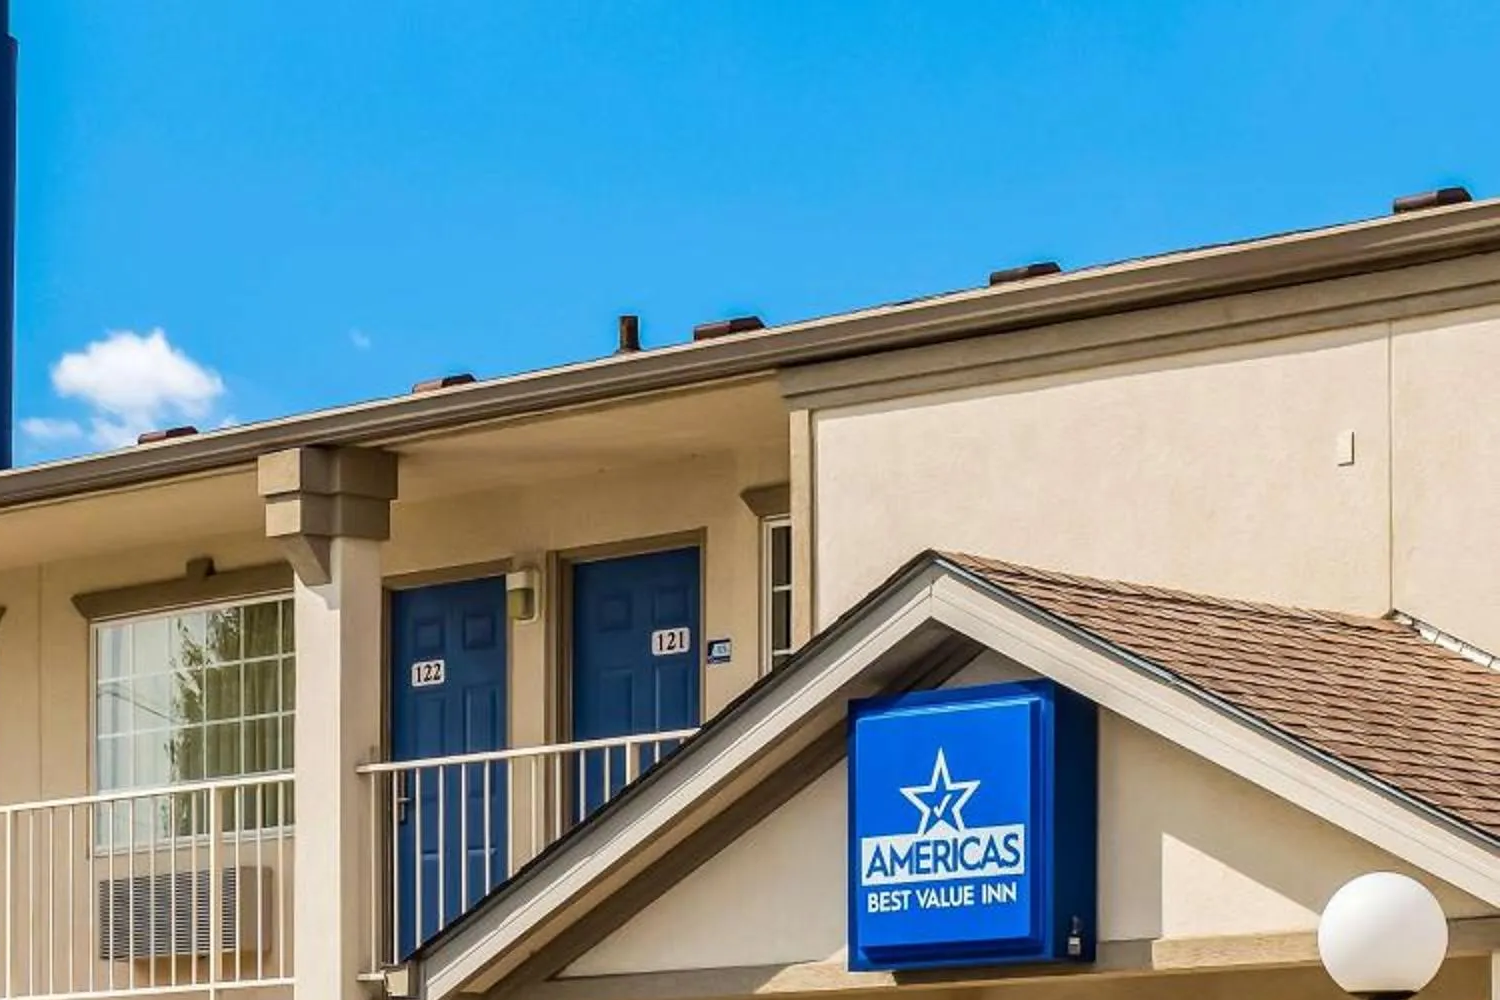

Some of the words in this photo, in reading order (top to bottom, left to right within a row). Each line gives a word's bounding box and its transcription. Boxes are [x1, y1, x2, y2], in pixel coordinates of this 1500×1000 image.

[657, 631, 686, 651] 121
[415, 663, 442, 683] 122
[865, 833, 1021, 878] AMERICAS
[867, 890, 912, 913] BEST
[915, 885, 974, 909] VALUE
[982, 881, 1017, 905] INN
